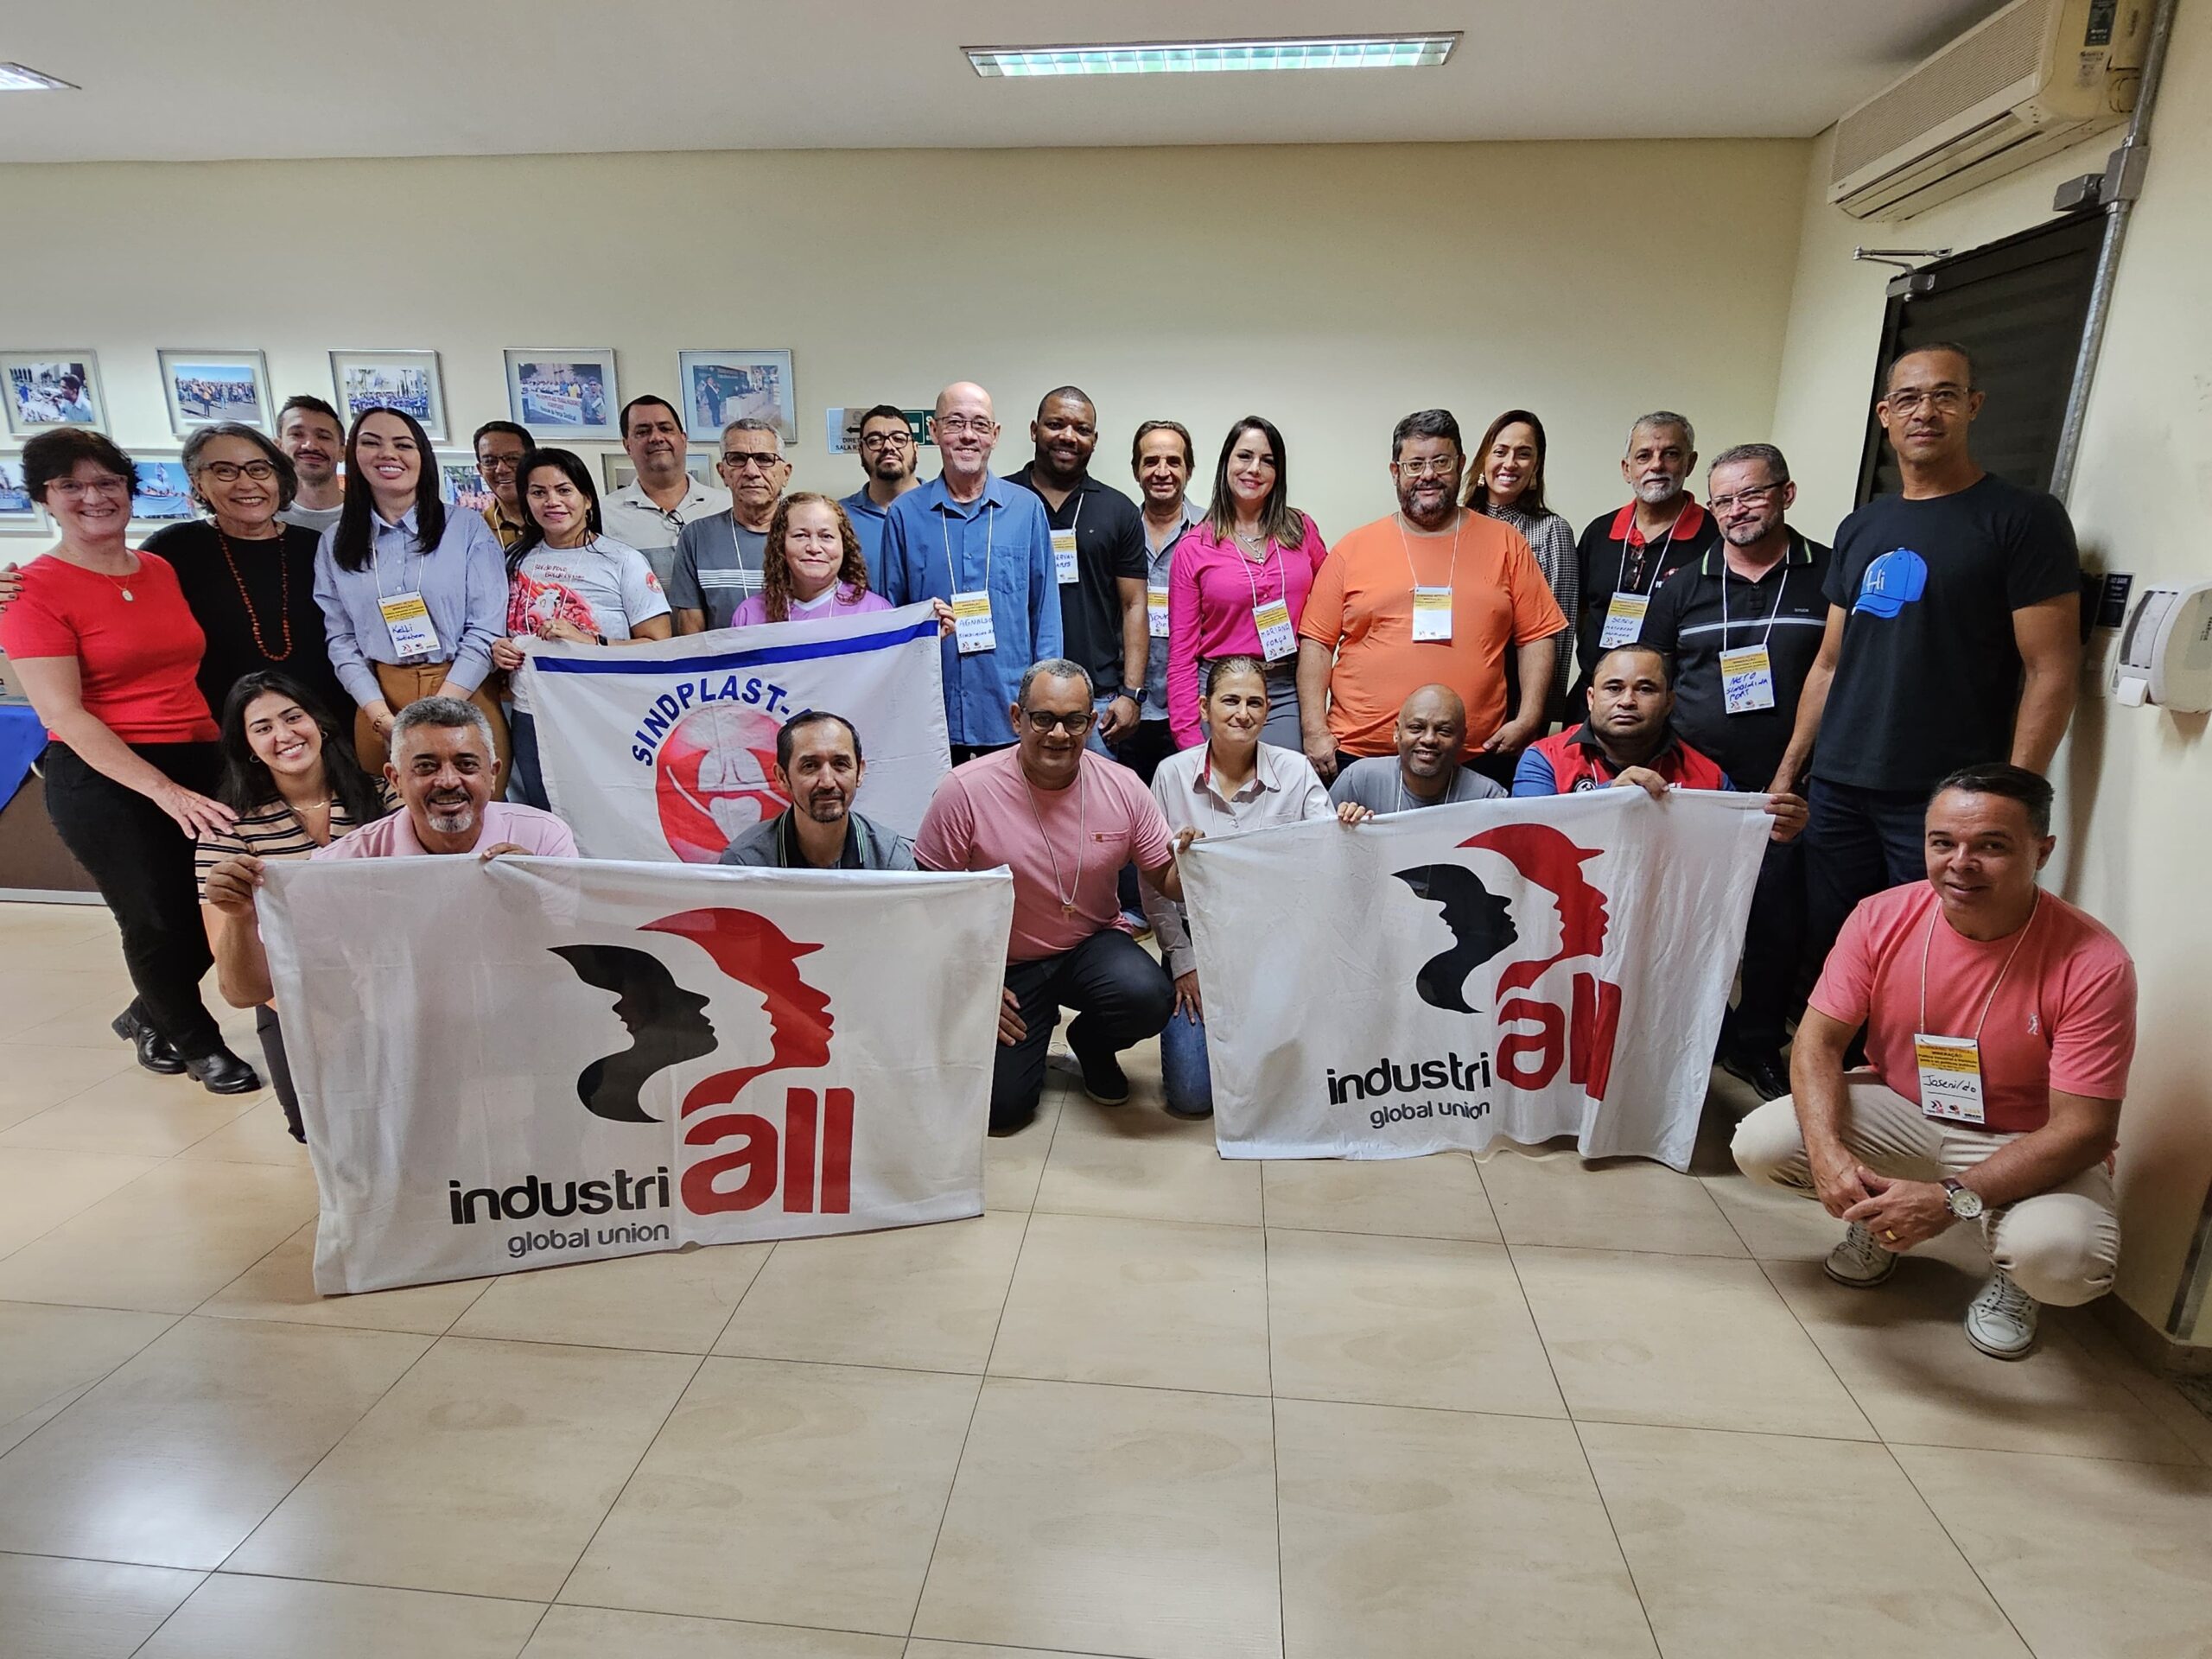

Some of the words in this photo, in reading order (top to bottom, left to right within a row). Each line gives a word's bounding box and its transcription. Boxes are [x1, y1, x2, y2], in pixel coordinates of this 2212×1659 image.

[1866, 569, 1885, 591] Hi
[1730, 671, 1757, 686] NETO
[632, 675, 815, 767] SINDPLAST-
[1370, 1100, 1433, 1129] global
[1439, 1100, 1491, 1121] union
[507, 1228, 589, 1258] global
[598, 1222, 670, 1246] union
